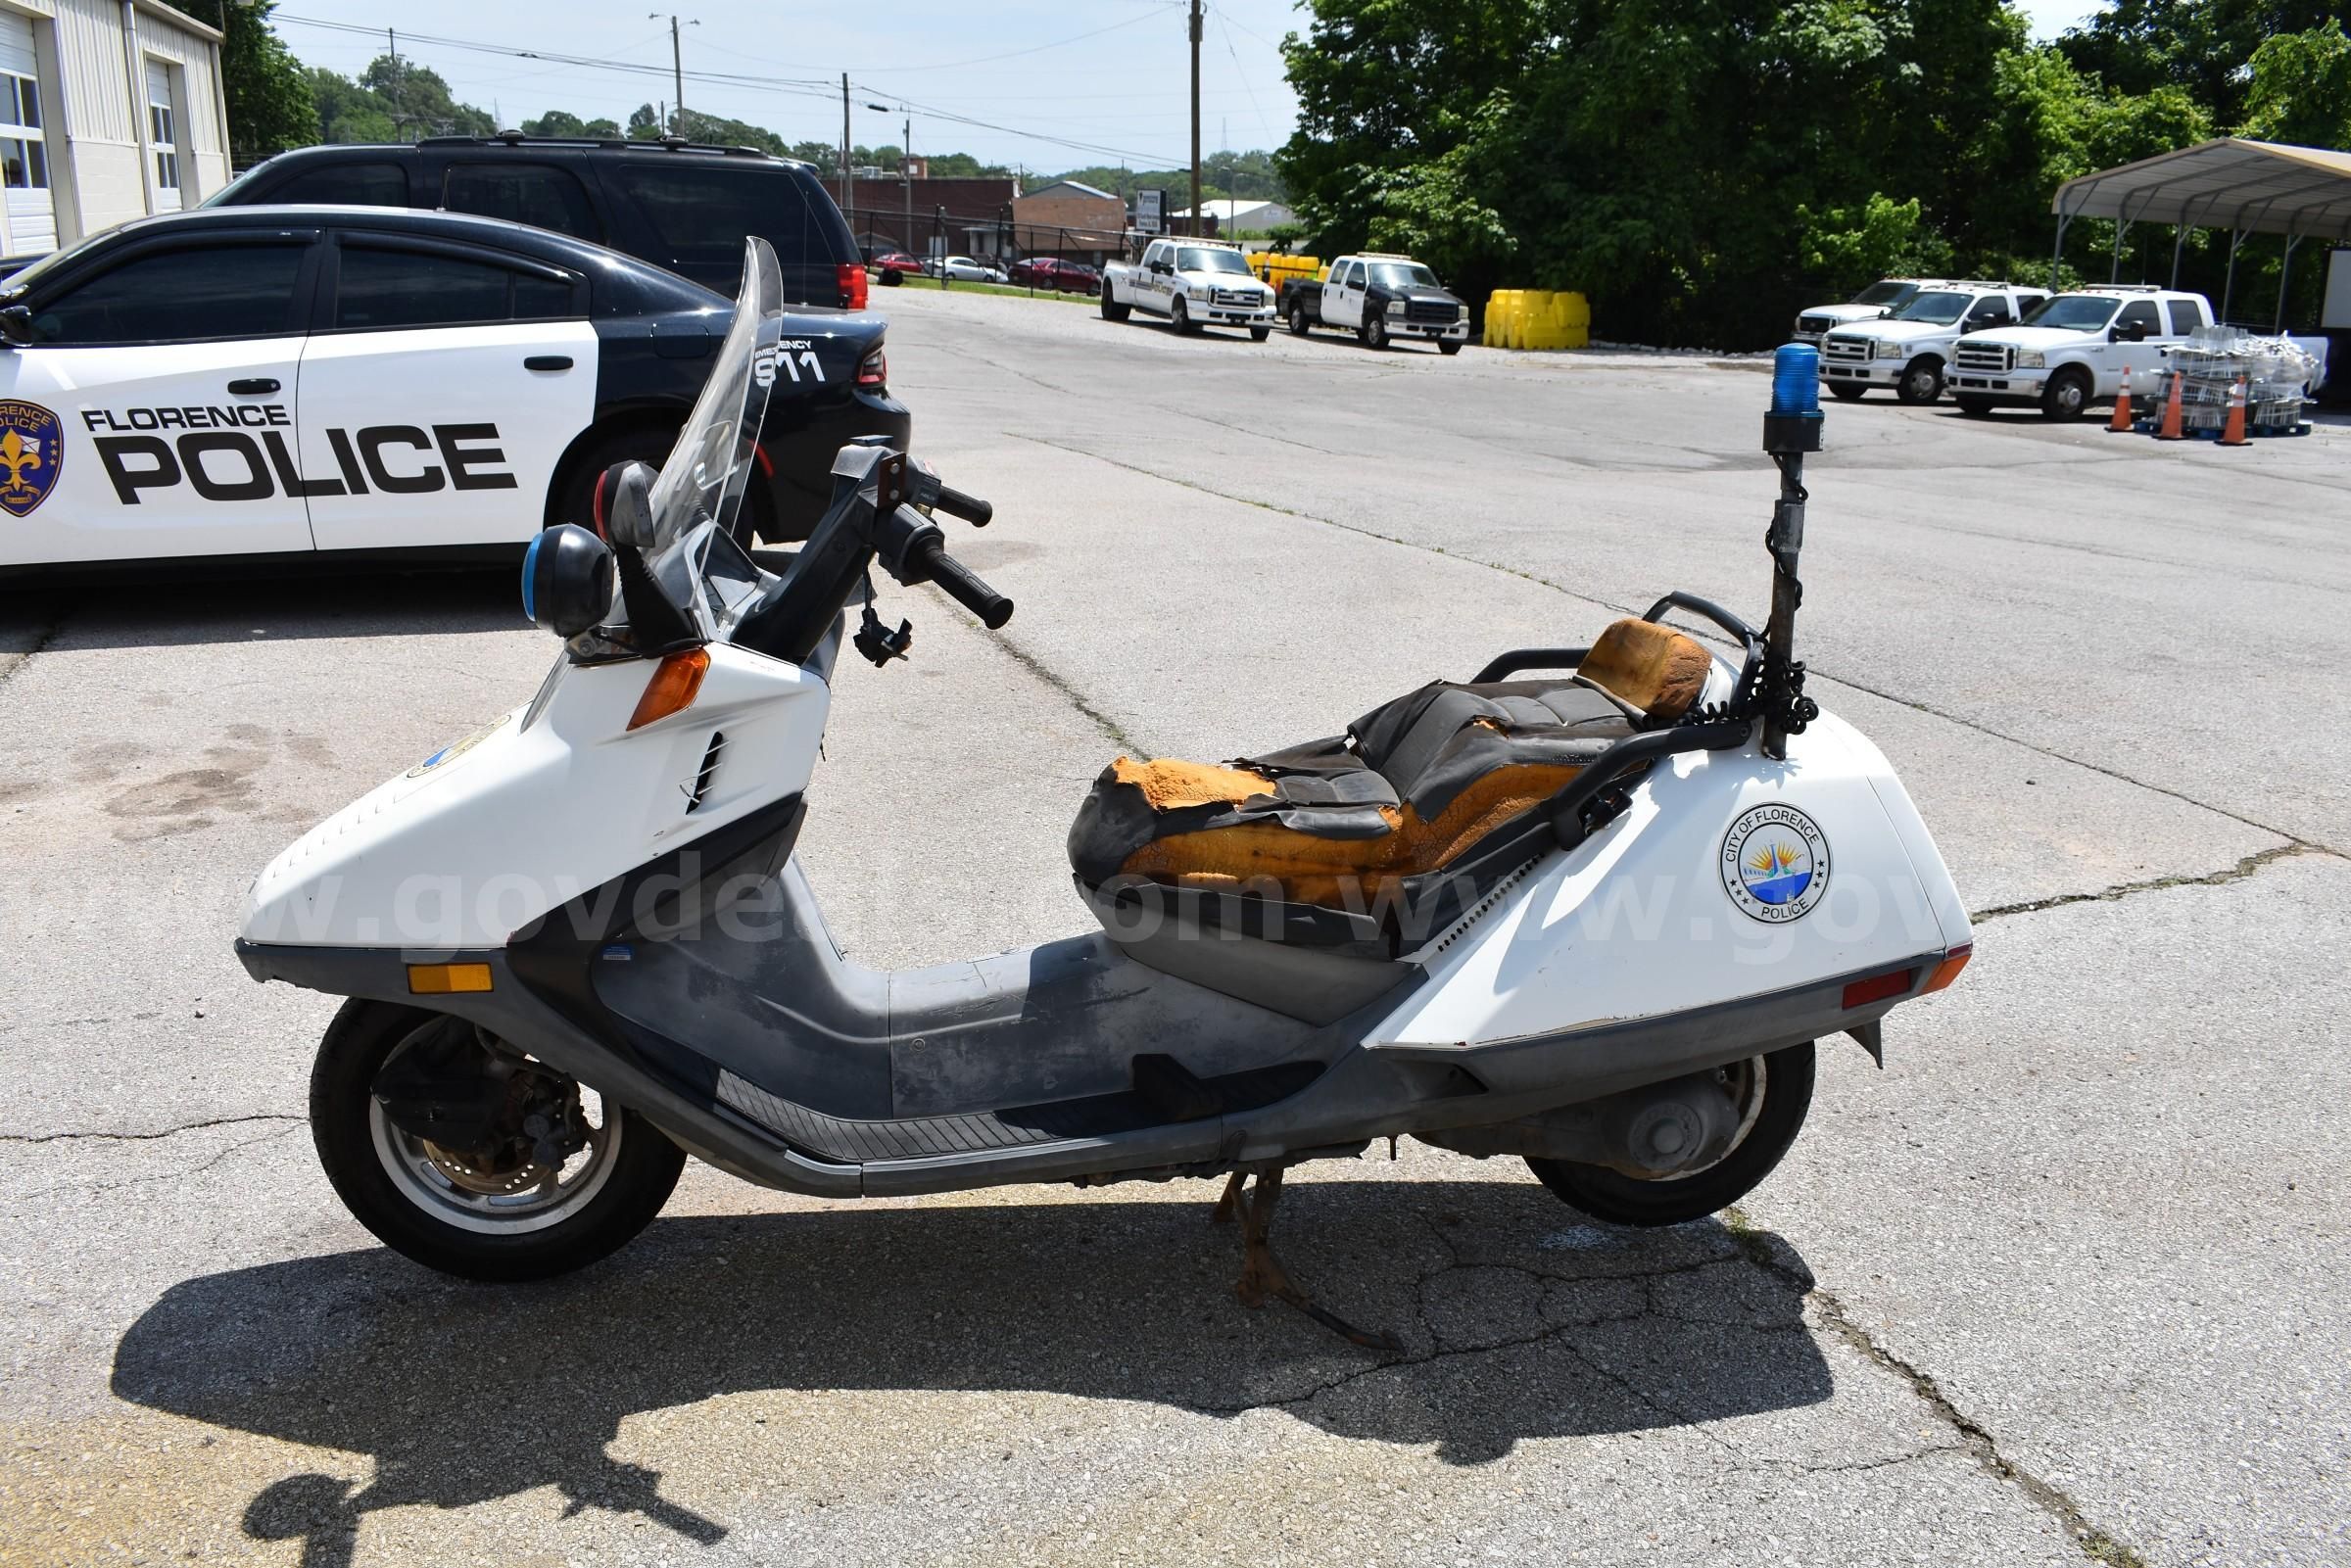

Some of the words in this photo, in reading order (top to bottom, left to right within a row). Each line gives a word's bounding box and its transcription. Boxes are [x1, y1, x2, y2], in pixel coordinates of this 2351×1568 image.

[754, 340, 811, 359] EMEENCY
[754, 352, 826, 387] 911
[81, 404, 291, 432] FLORENCE
[93, 422, 518, 505] POLICE
[1725, 832, 1742, 863] CITY
[1738, 816, 1754, 833] OF
[1754, 808, 1820, 845] FLORENCE
[1760, 897, 1809, 920] POLICE
